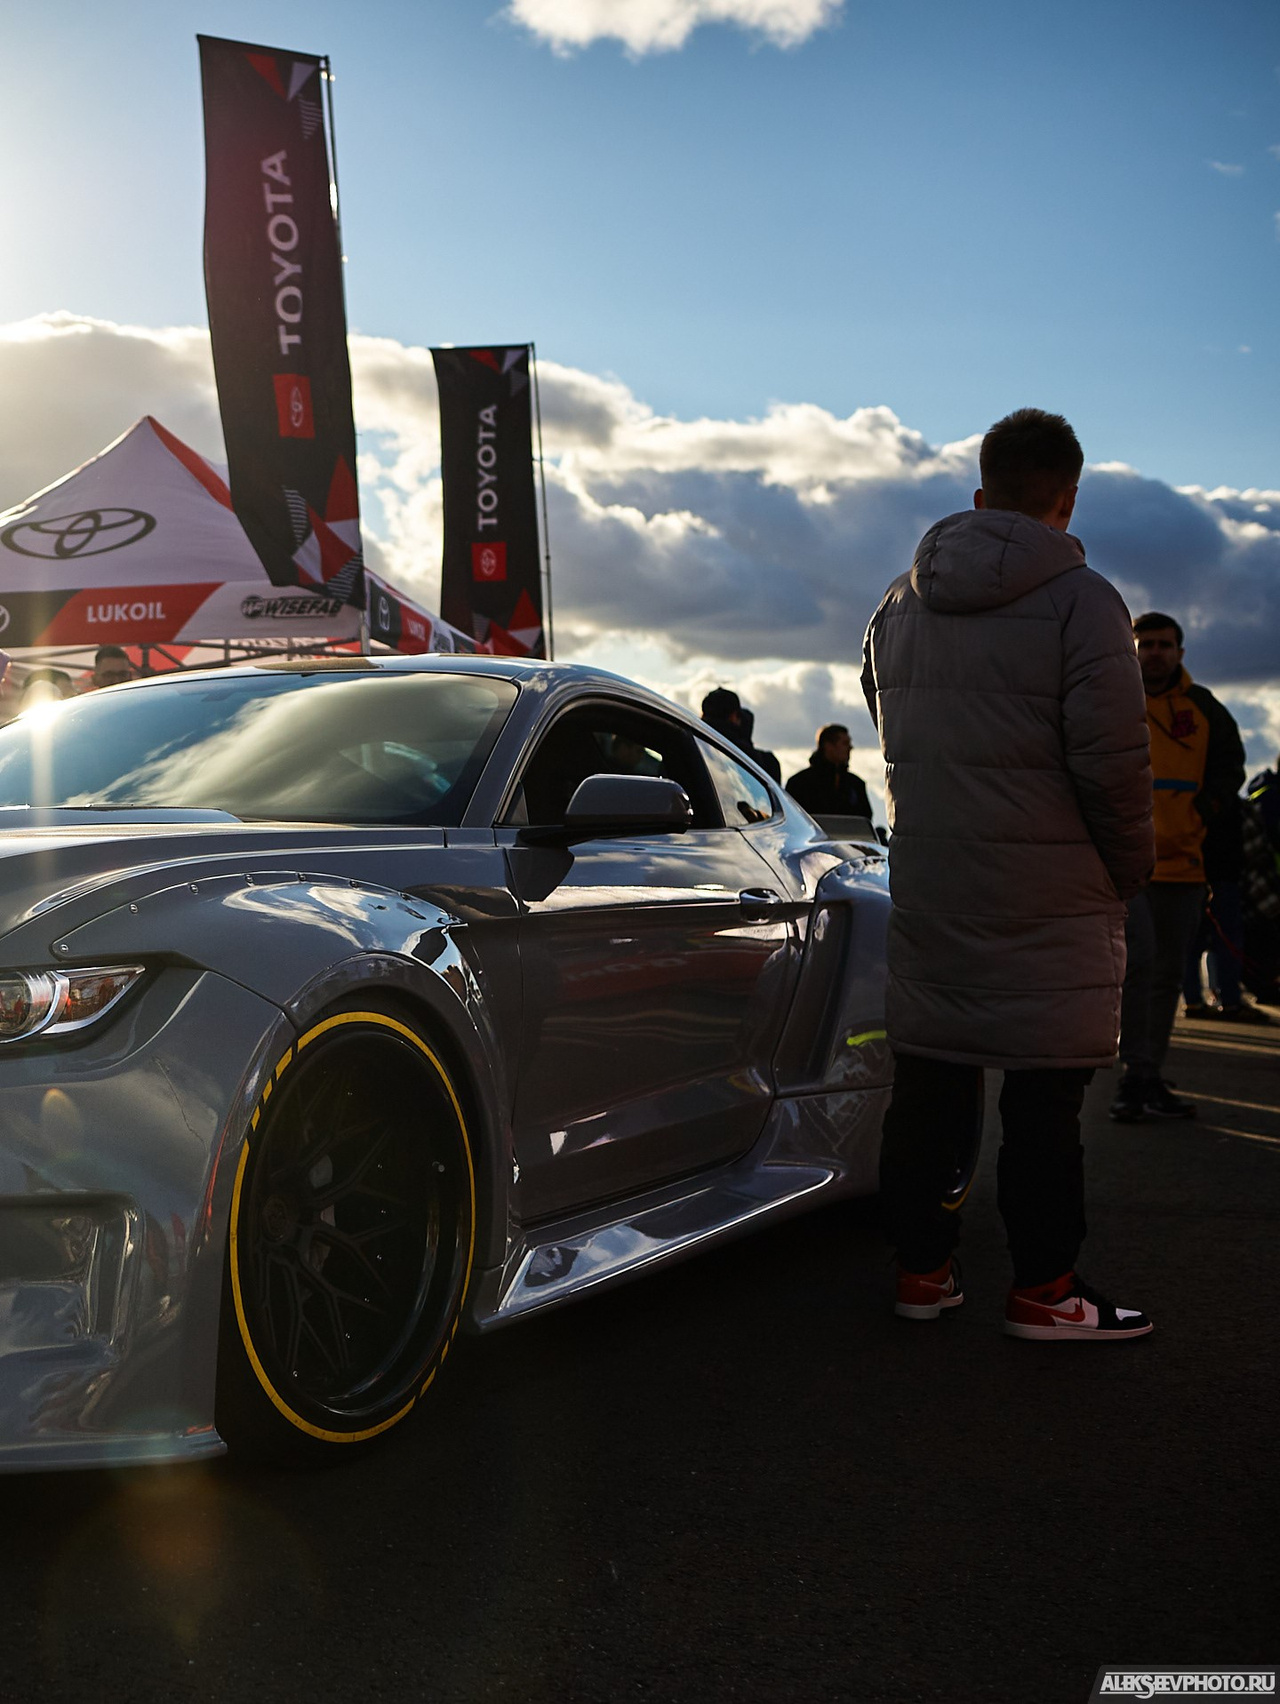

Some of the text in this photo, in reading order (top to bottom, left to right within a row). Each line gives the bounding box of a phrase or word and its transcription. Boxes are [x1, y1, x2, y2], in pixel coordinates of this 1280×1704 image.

[261, 149, 303, 356] TOYOTA
[477, 404, 498, 532] TOYOTA
[86, 601, 166, 623] LUKOIL
[265, 598, 343, 615] WISEFAB
